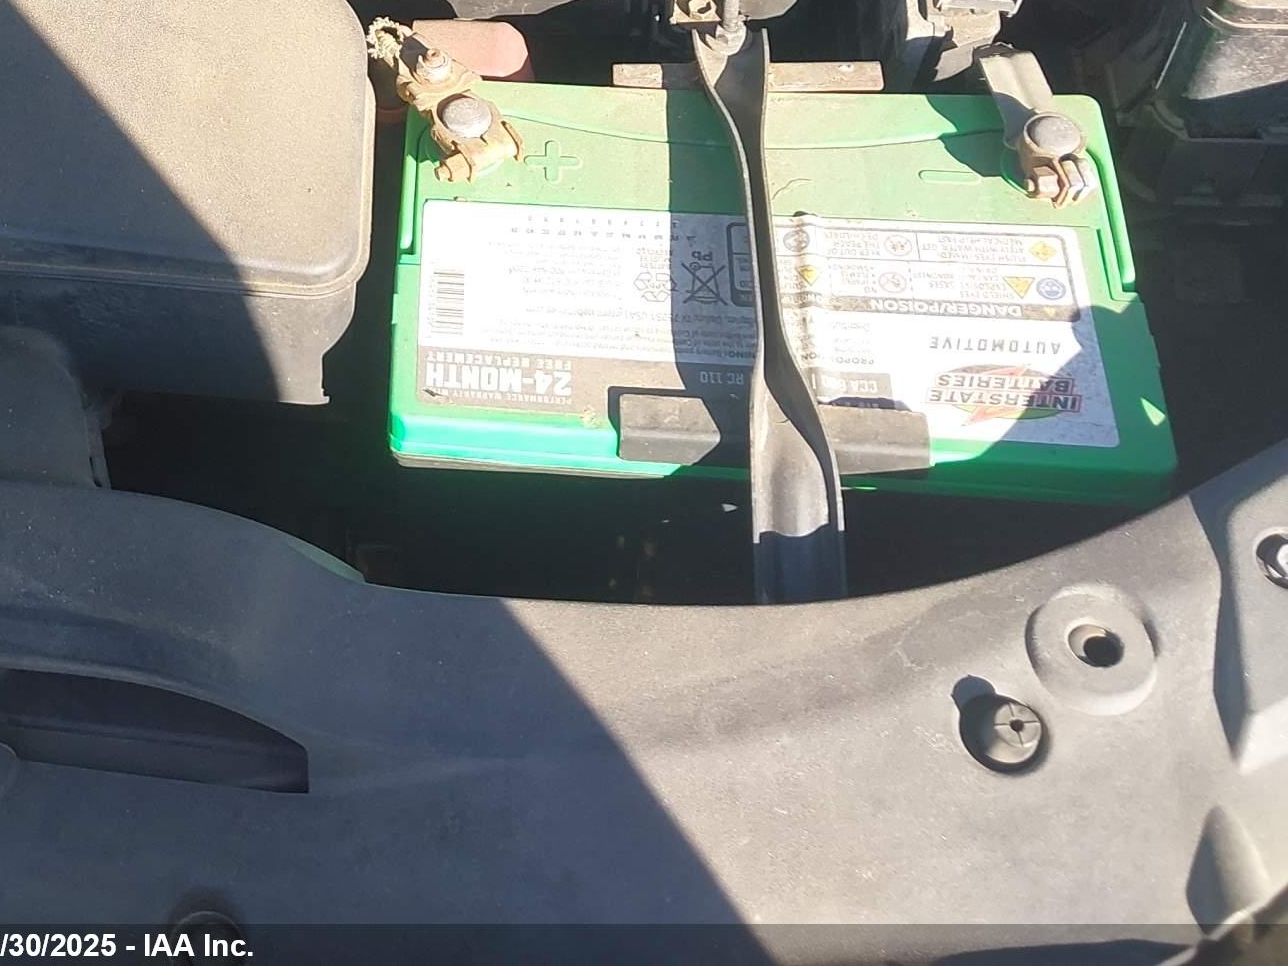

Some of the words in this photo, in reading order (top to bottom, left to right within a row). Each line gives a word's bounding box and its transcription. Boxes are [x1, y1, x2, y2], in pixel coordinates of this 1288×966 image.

[691, 251, 712, 261] Pb
[870, 299, 1022, 317] DANGER/POISON
[929, 336, 1061, 356] AUTOMOTIVE
[426, 351, 532, 368] REPLACEMENT
[535, 356, 572, 371] FREE
[425, 362, 573, 395] 24-MONTH
[699, 371, 722, 384] 110
[727, 372, 744, 384] RC
[934, 373, 1074, 394] BATTERIES
[849, 380, 878, 393] CCA
[505, 392, 572, 405] PERFORMANCE
[928, 389, 1081, 410] INTERSTATE
